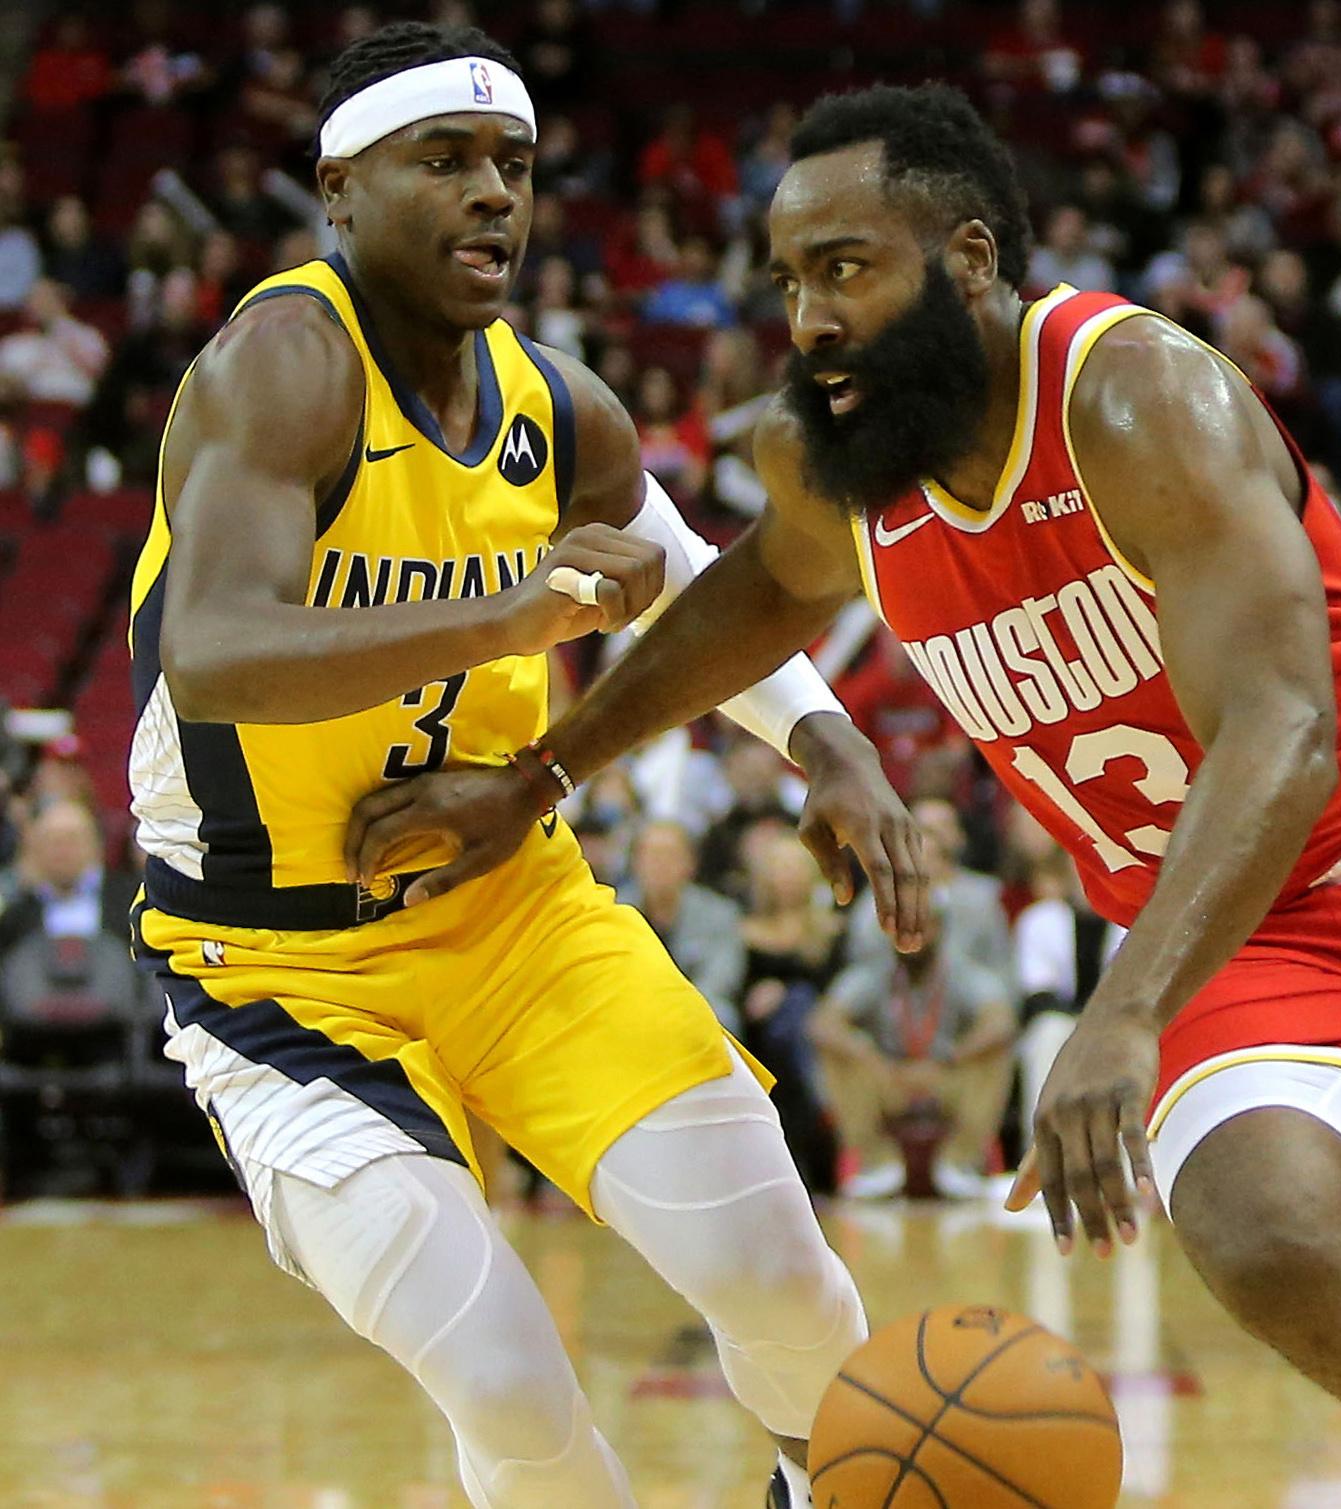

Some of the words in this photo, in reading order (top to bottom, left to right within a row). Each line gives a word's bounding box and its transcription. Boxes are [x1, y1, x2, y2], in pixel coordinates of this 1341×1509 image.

[305, 544, 553, 608] INDIAN
[381, 668, 470, 781] 3
[1011, 723, 1193, 874] 13
